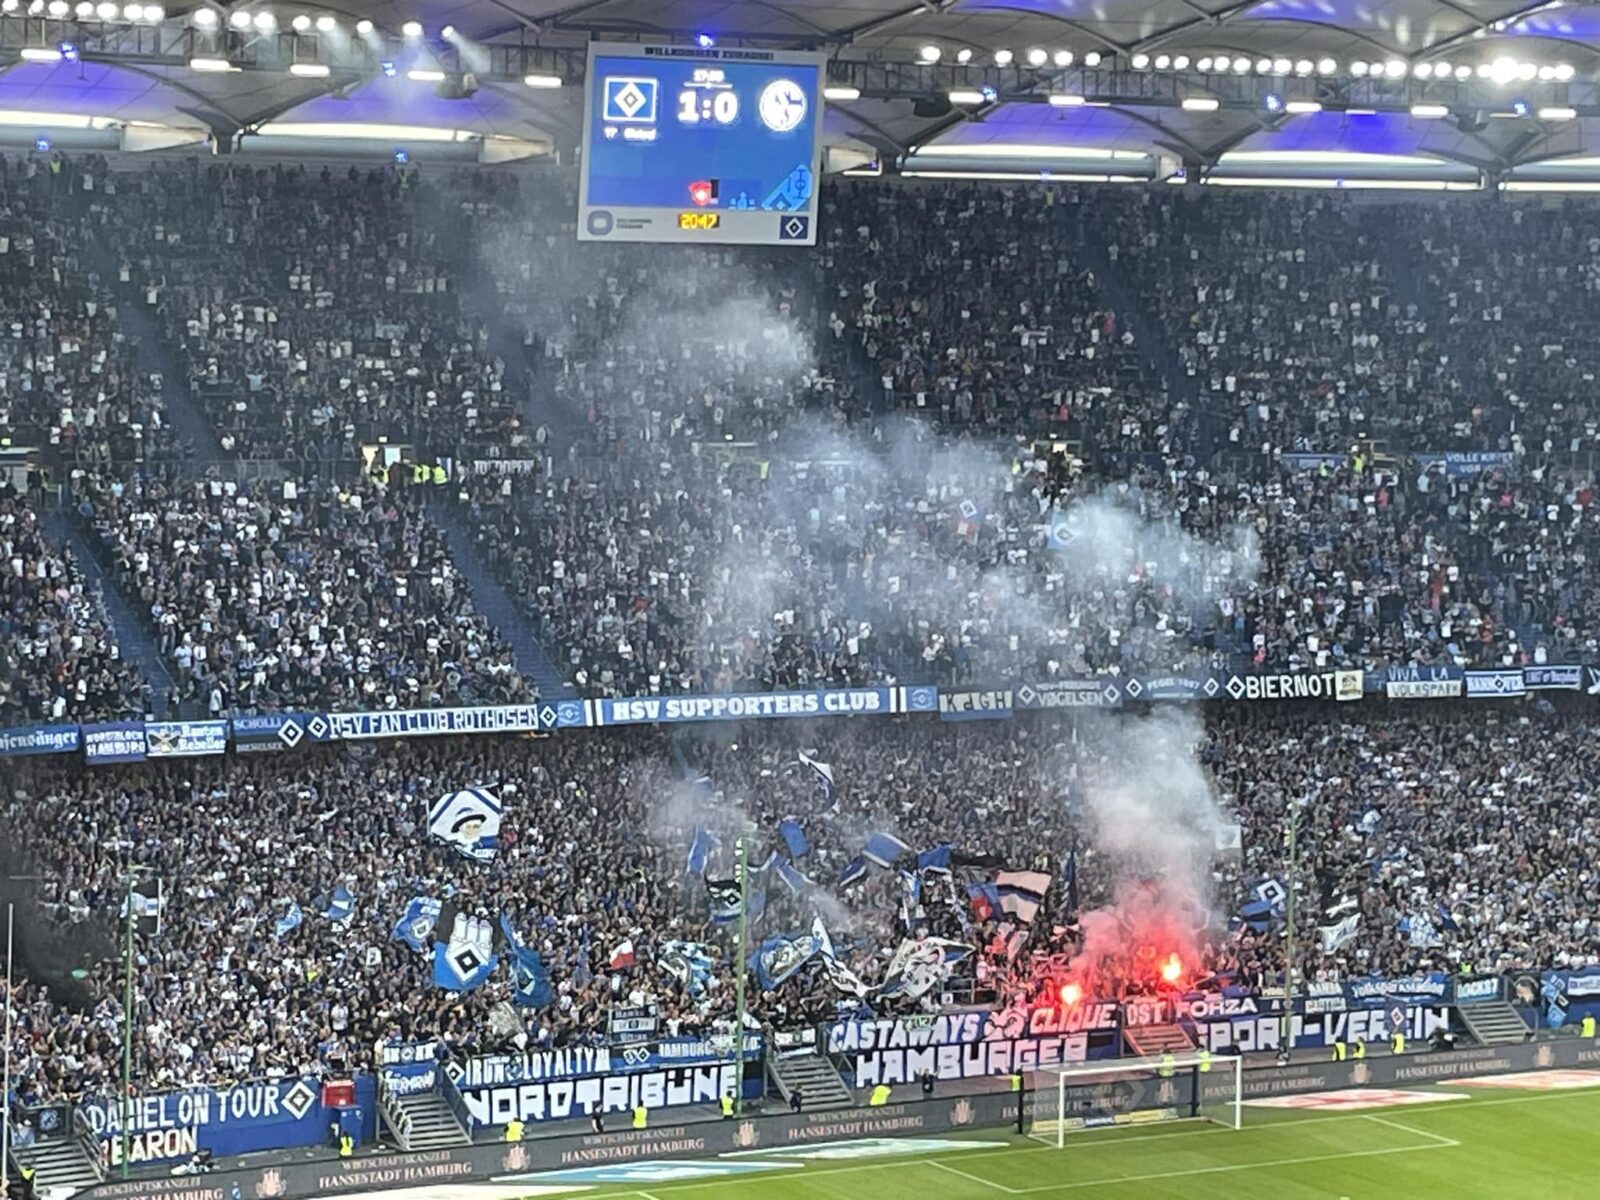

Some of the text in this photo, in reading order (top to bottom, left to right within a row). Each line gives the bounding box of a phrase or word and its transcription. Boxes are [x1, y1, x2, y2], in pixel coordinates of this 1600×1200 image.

[677, 91, 738, 124] 1:0
[1245, 673, 1335, 698] BIERNOT
[370, 712, 400, 733] FAN
[408, 708, 449, 731] CLUB
[453, 703, 537, 730] ROTHOSEN
[613, 691, 880, 720] HSV SUPPORTERS CLUB
[1176, 997, 1258, 1019] FORZA
[829, 1014, 981, 1053] CASTAWAYS
[523, 1046, 593, 1080] LOYALTY
[856, 1031, 1089, 1088] HAMBURGER
[463, 1063, 739, 1125] NORDTRIBÜNE
[87, 1086, 279, 1134] DANIEL ON TOUR
[788, 1115, 924, 1140] HANSESTADT HAMBURG
[561, 1138, 705, 1163] HANSESTADT HAMBURG
[319, 1161, 473, 1189] HANSESTADT HAMBURG
